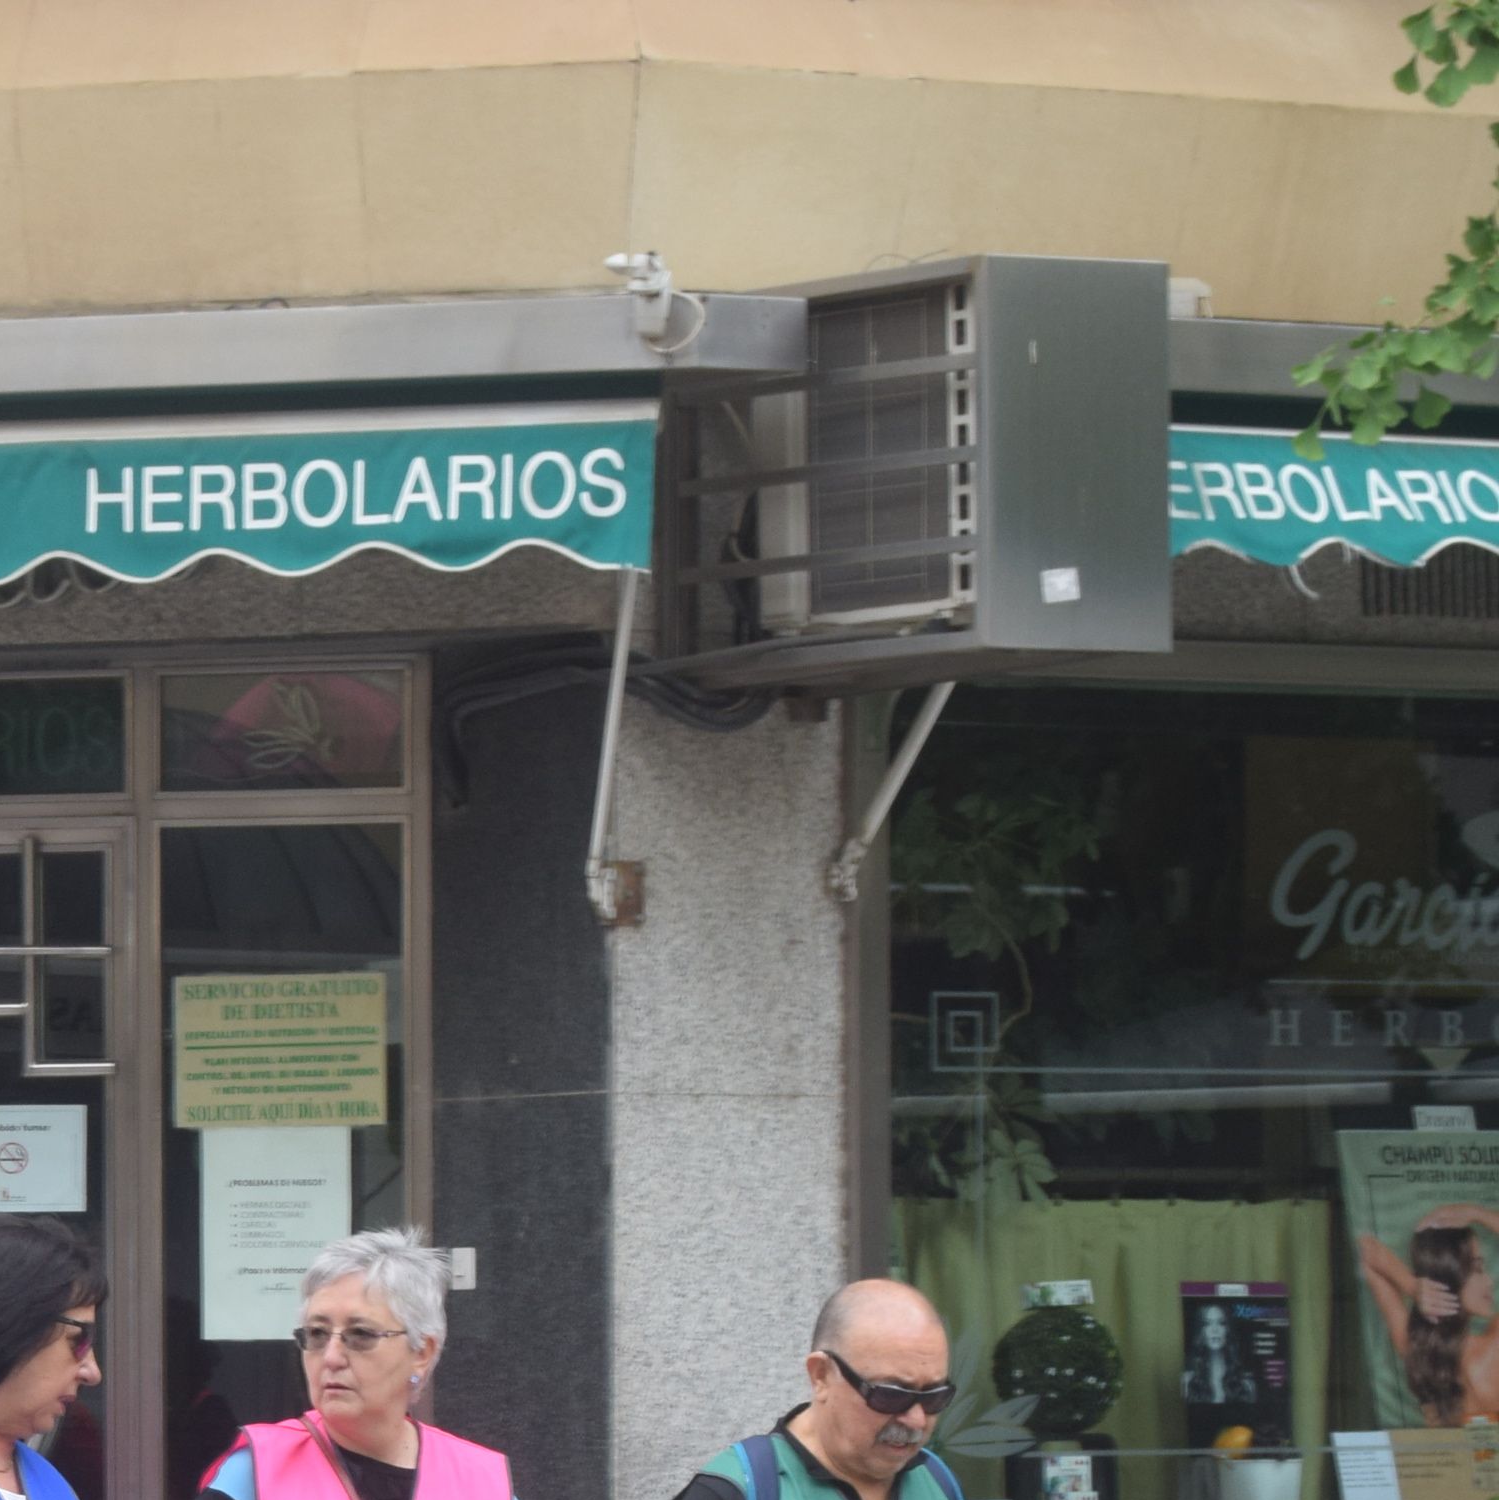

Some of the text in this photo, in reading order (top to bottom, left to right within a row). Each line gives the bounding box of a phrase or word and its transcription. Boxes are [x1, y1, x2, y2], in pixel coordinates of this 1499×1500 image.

[85, 449, 627, 534] HERBOLARIOS
[1168, 461, 1499, 524] ERBOLARIO
[183, 978, 380, 1000] SERVICIO GRATUITO
[222, 1001, 340, 1021] DE DIETISTA
[1269, 1009, 1499, 1047] HERB
[187, 1103, 254, 1121] SOLICITE
